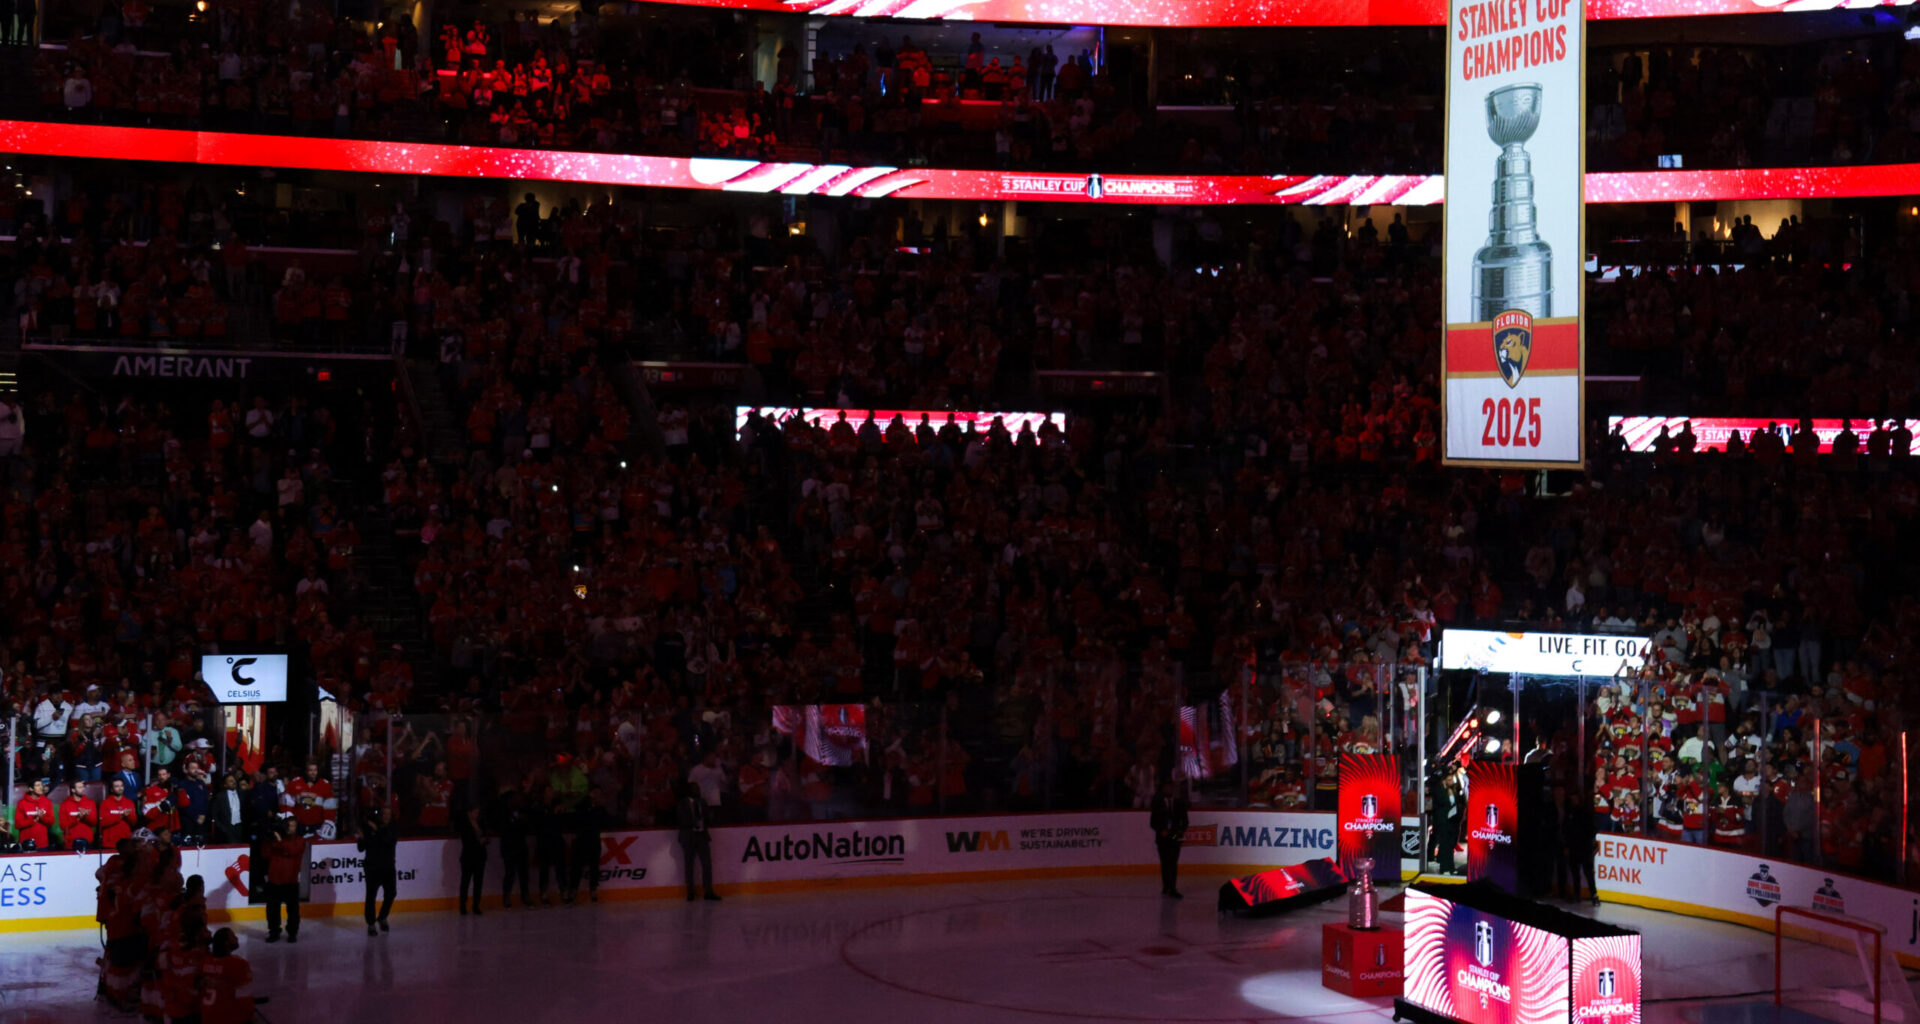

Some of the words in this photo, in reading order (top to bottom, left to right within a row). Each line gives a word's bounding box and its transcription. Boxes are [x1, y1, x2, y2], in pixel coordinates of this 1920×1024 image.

[1458, 0, 1527, 41] STANLEY
[1462, 24, 1567, 81] CHAMPIONS
[1012, 179, 1062, 191] STANLEY
[1063, 180, 1086, 192] CUP
[1104, 182, 1175, 194] CHAMPIONS
[1496, 313, 1529, 329] FLORIDA
[112, 354, 252, 379] AMERANT
[1481, 397, 1542, 448] 2025
[1539, 636, 1578, 655] LIVE.
[1583, 638, 1610, 656] FIT.
[227, 690, 261, 698] CELSIUS
[1056, 827, 1099, 837] DRIVING
[1344, 822, 1394, 831] CHAMPIONS
[742, 830, 905, 863] AutoNation
[945, 830, 1010, 852] WM
[1019, 839, 1103, 850] SUSTAINABILITY
[1220, 826, 1334, 850] AMAZING
[1471, 830, 1511, 844] CHAMPIONS
[311, 861, 327, 870] oe
[1598, 864, 1642, 885] BANK
[1457, 969, 1511, 1001] CHAMPIONS
[1579, 1003, 1634, 1016] CHAMPIONS
